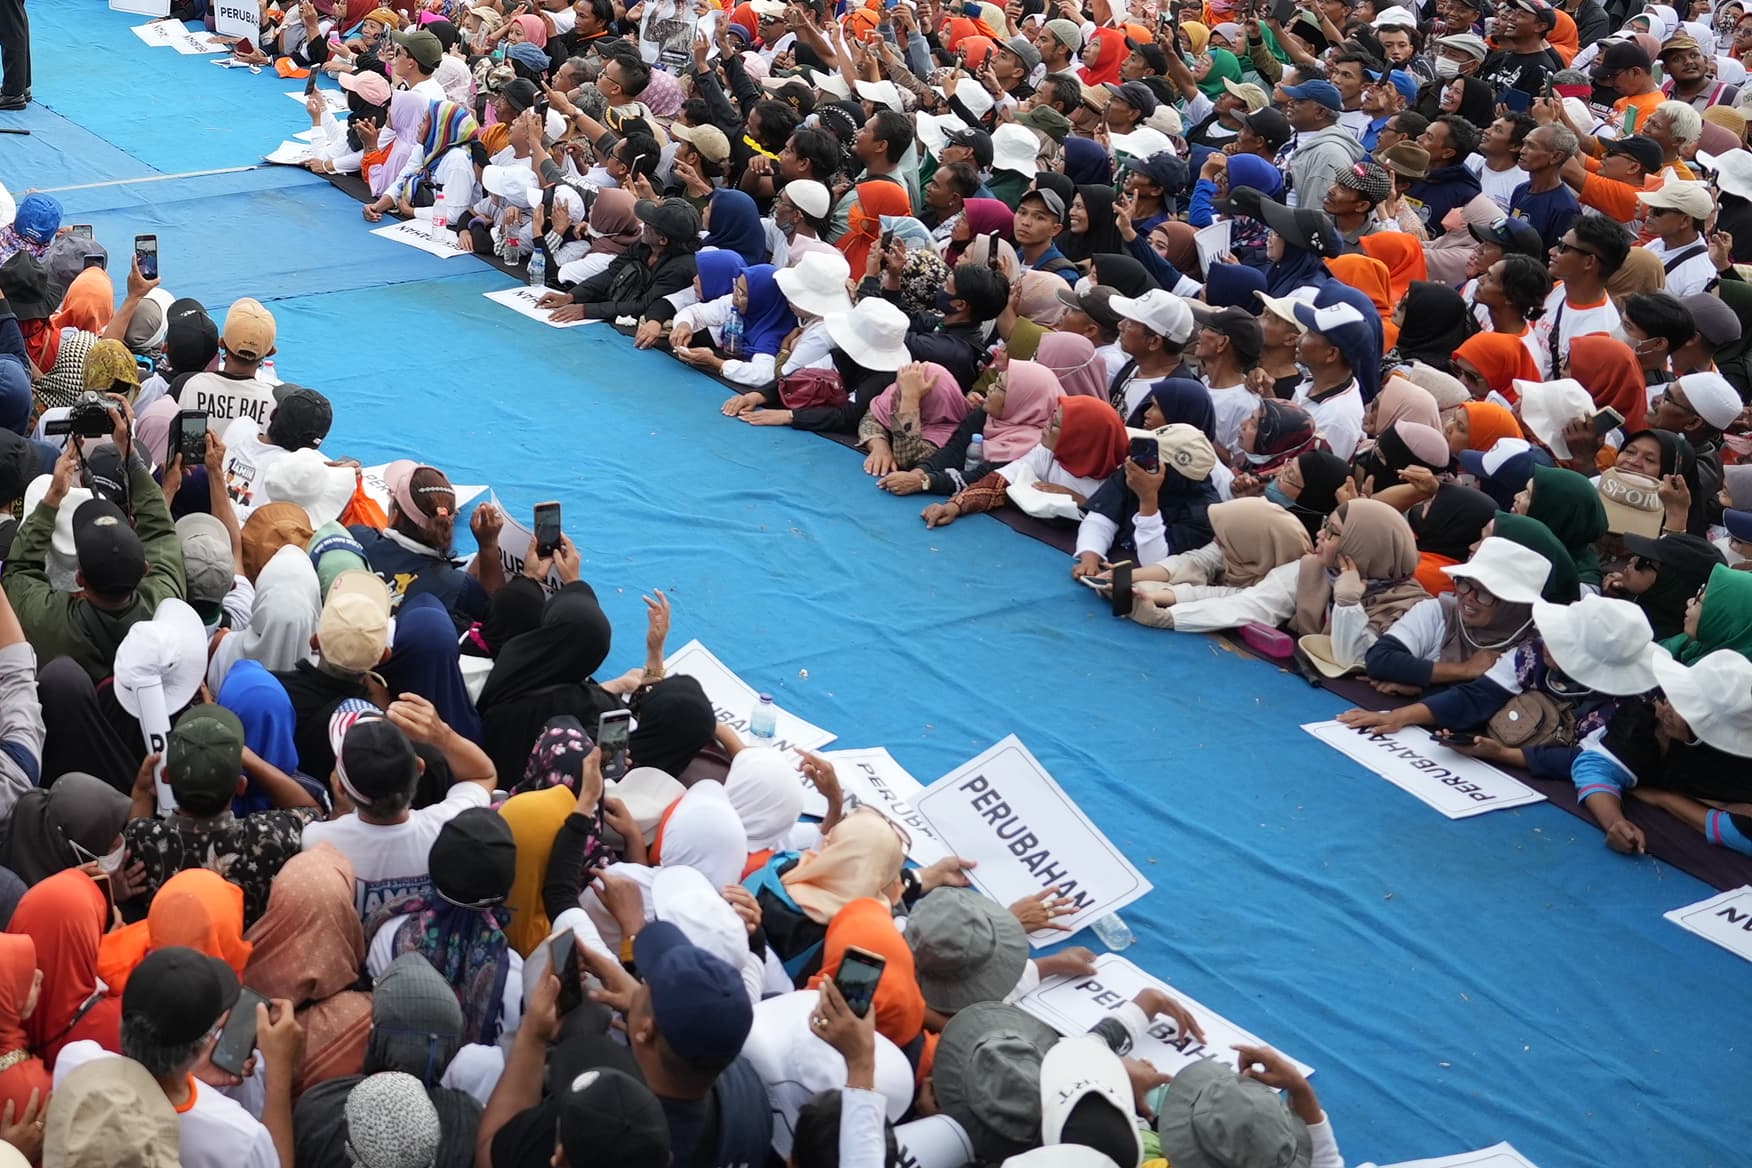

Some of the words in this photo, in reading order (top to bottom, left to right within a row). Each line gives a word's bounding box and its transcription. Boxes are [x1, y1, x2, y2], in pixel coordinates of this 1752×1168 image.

[220, 7, 260, 26] PERUBA
[197, 392, 234, 420] PASE
[239, 396, 268, 425] BAE
[856, 762, 937, 839] PERUBA
[960, 775, 1095, 913] PERUBAHAN
